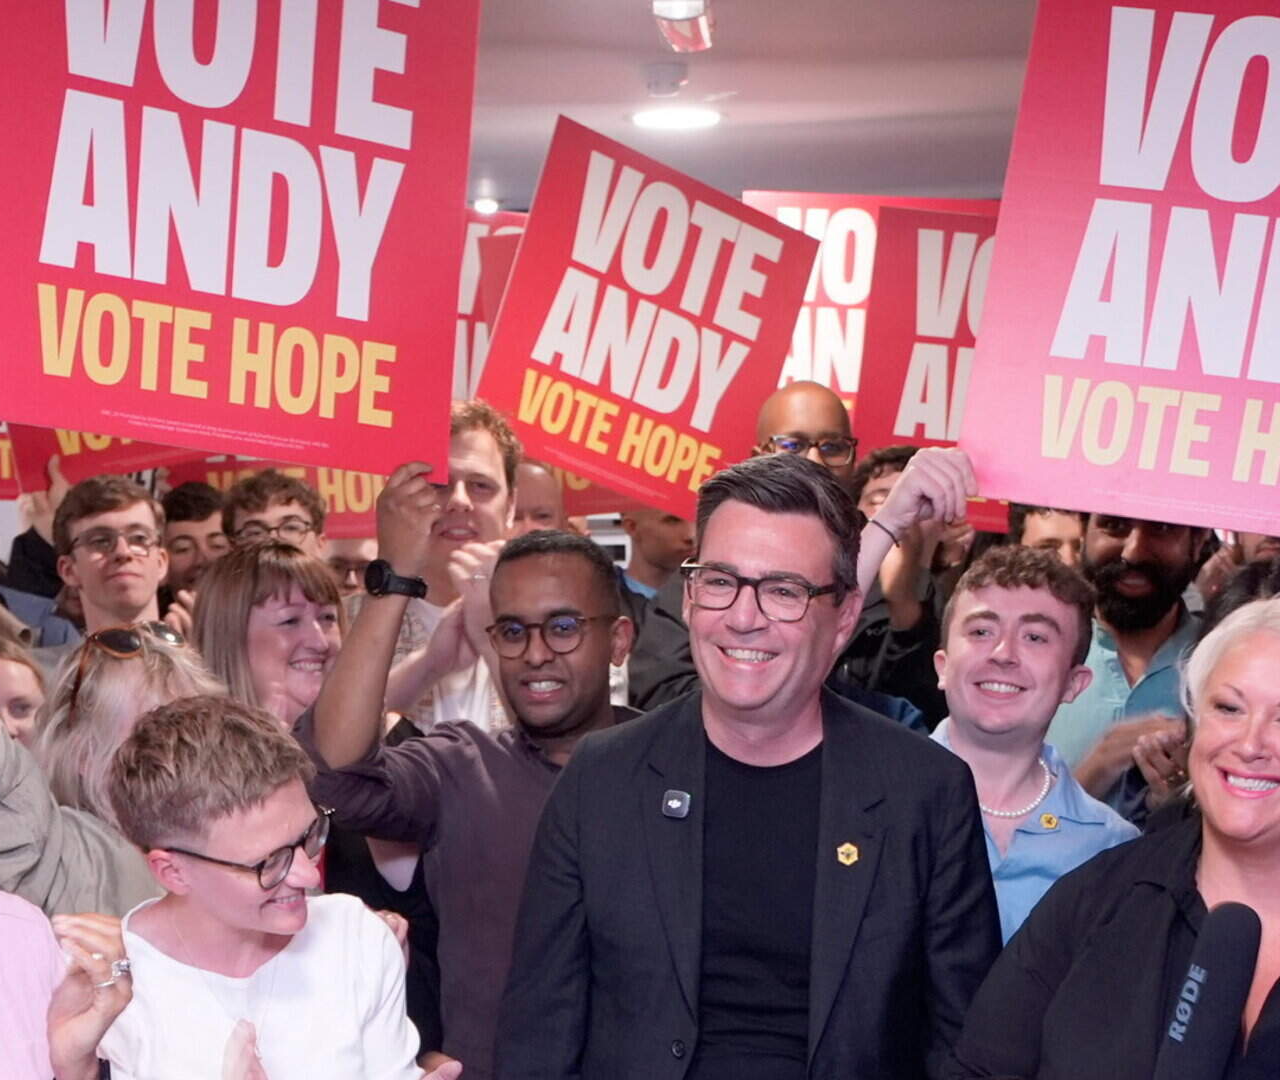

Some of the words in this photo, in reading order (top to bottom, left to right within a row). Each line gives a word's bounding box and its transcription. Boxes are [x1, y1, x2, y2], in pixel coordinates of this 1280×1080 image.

[38, 87, 406, 322] ANDY
[571, 150, 784, 341] VOTE
[37, 283, 212, 399] VOTE
[229, 317, 397, 428] HOPE
[531, 267, 751, 432] ANDY
[777, 306, 866, 392] AN
[318, 467, 390, 513] HO
[517, 368, 619, 454] VOTE
[617, 413, 722, 493] HOPE
[1041, 374, 1222, 477] VOTE
